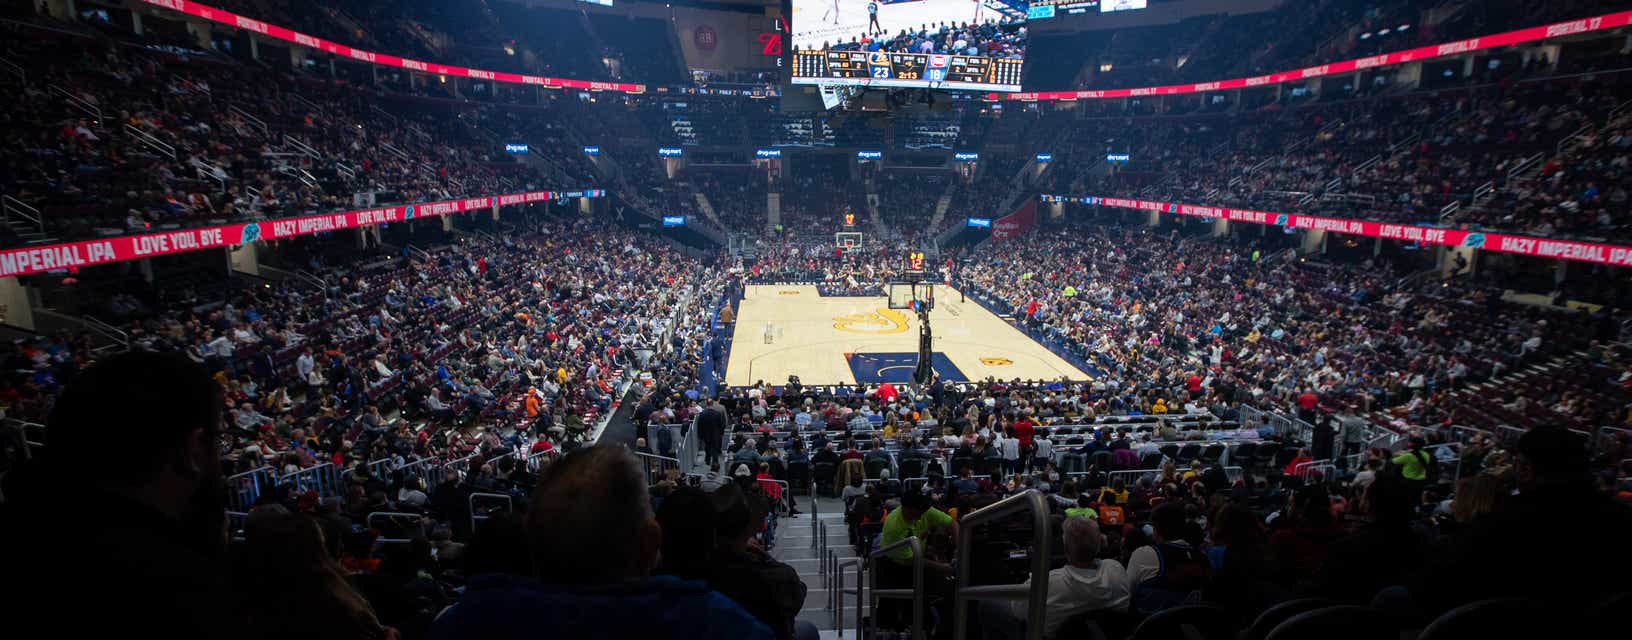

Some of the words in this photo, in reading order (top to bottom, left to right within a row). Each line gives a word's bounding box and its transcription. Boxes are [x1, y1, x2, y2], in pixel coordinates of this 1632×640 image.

[1546, 22, 1588, 37] PORTAL
[1588, 17, 1602, 31] 17
[1437, 41, 1468, 55] PORTAL
[1468, 38, 1480, 51] 17
[402, 59, 422, 70] PORTAL
[467, 69, 489, 79] PORTAL
[874, 67, 890, 78] 23
[898, 71, 918, 80] 2:13
[929, 69, 942, 81] 18
[522, 75, 545, 85] PORTAL
[544, 77, 551, 86] 17
[590, 82, 612, 91] PORTAL
[1130, 88, 1150, 96] PORTAL
[274, 221, 297, 237] HAZY
[299, 216, 335, 233] IMPERIAL
[335, 214, 348, 228] IPA
[1296, 216, 1313, 228] HAZY
[1314, 218, 1349, 232] IMPERIAL
[1350, 221, 1363, 233] IPA
[1380, 224, 1402, 238] LOVE
[1403, 226, 1424, 241] YOU,
[1425, 230, 1445, 243] BYE
[132, 234, 169, 255] LOVE
[169, 229, 200, 250] YOU,
[199, 228, 223, 246] BYE
[86, 241, 116, 262] IPA
[1502, 236, 1535, 254] HAZY
[1537, 241, 1605, 262] IMPERIAL
[911, 259, 922, 270] 12
